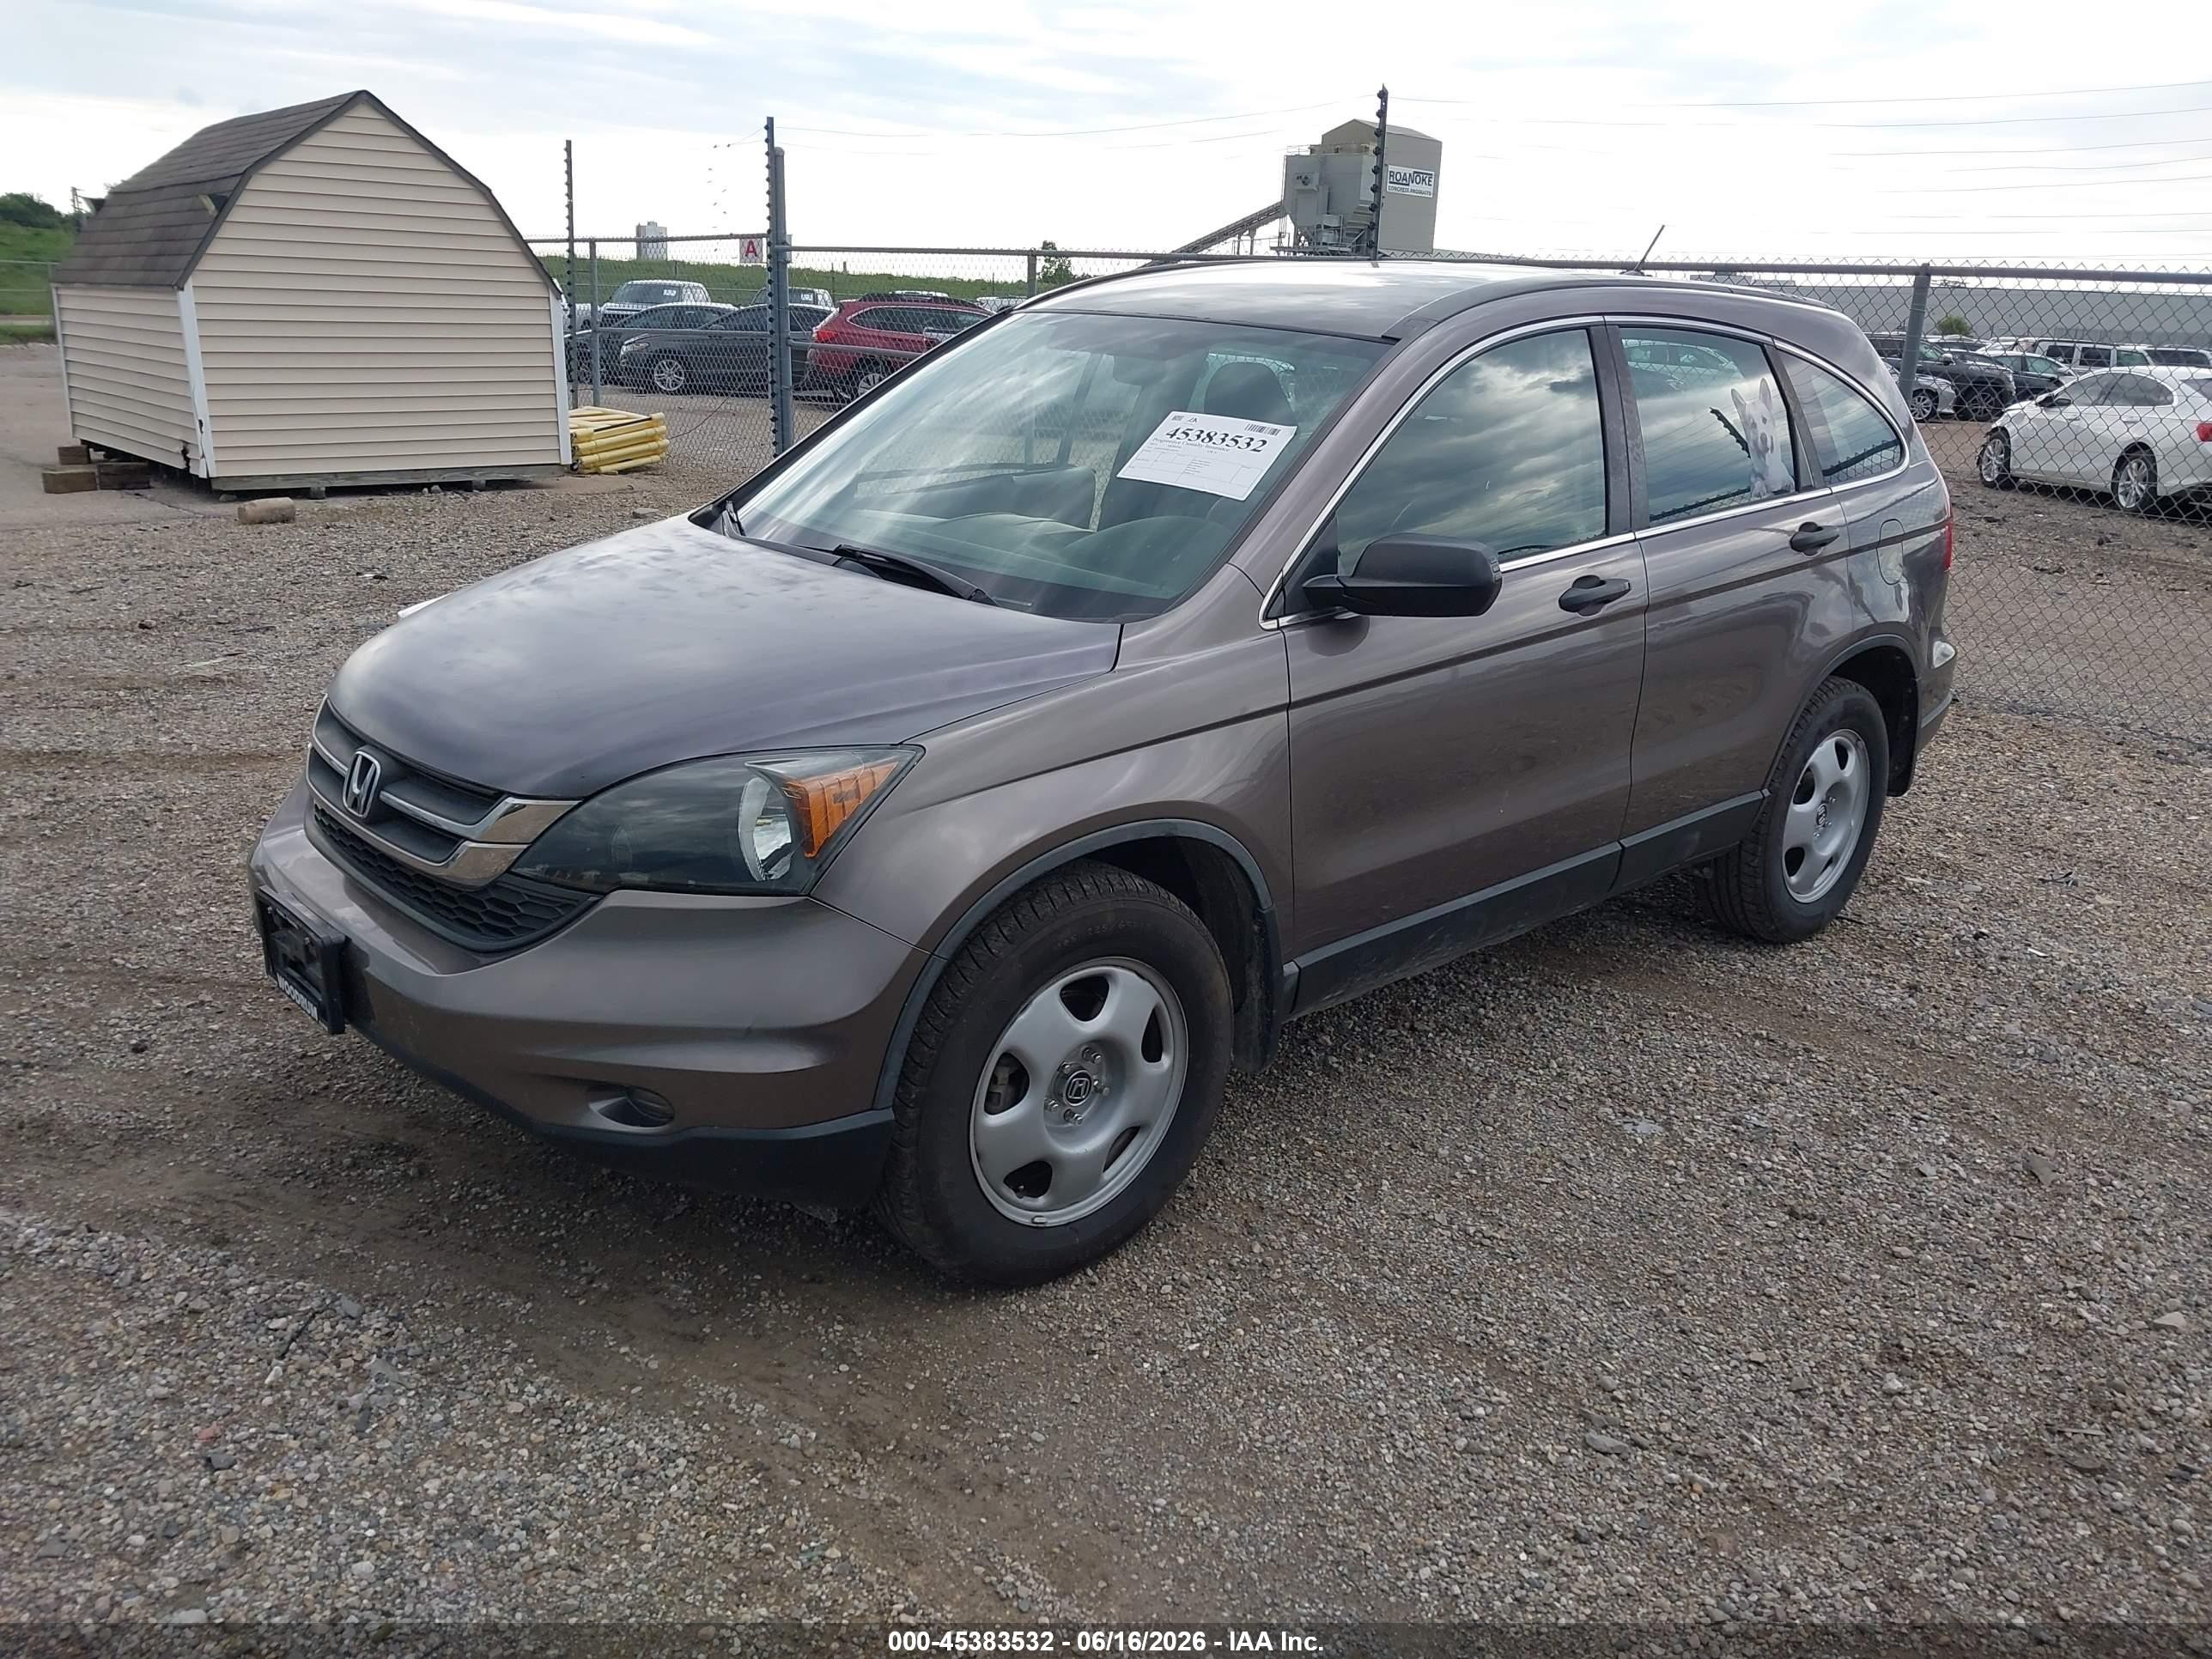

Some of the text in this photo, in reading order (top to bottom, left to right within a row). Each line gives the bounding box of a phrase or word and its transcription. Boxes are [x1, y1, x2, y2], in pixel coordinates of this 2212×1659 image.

[1389, 171, 1433, 186] ROANOKE
[744, 240, 757, 258] A
[1166, 427, 1268, 453] 45383532
[276, 972, 319, 1022] WOODRUM
